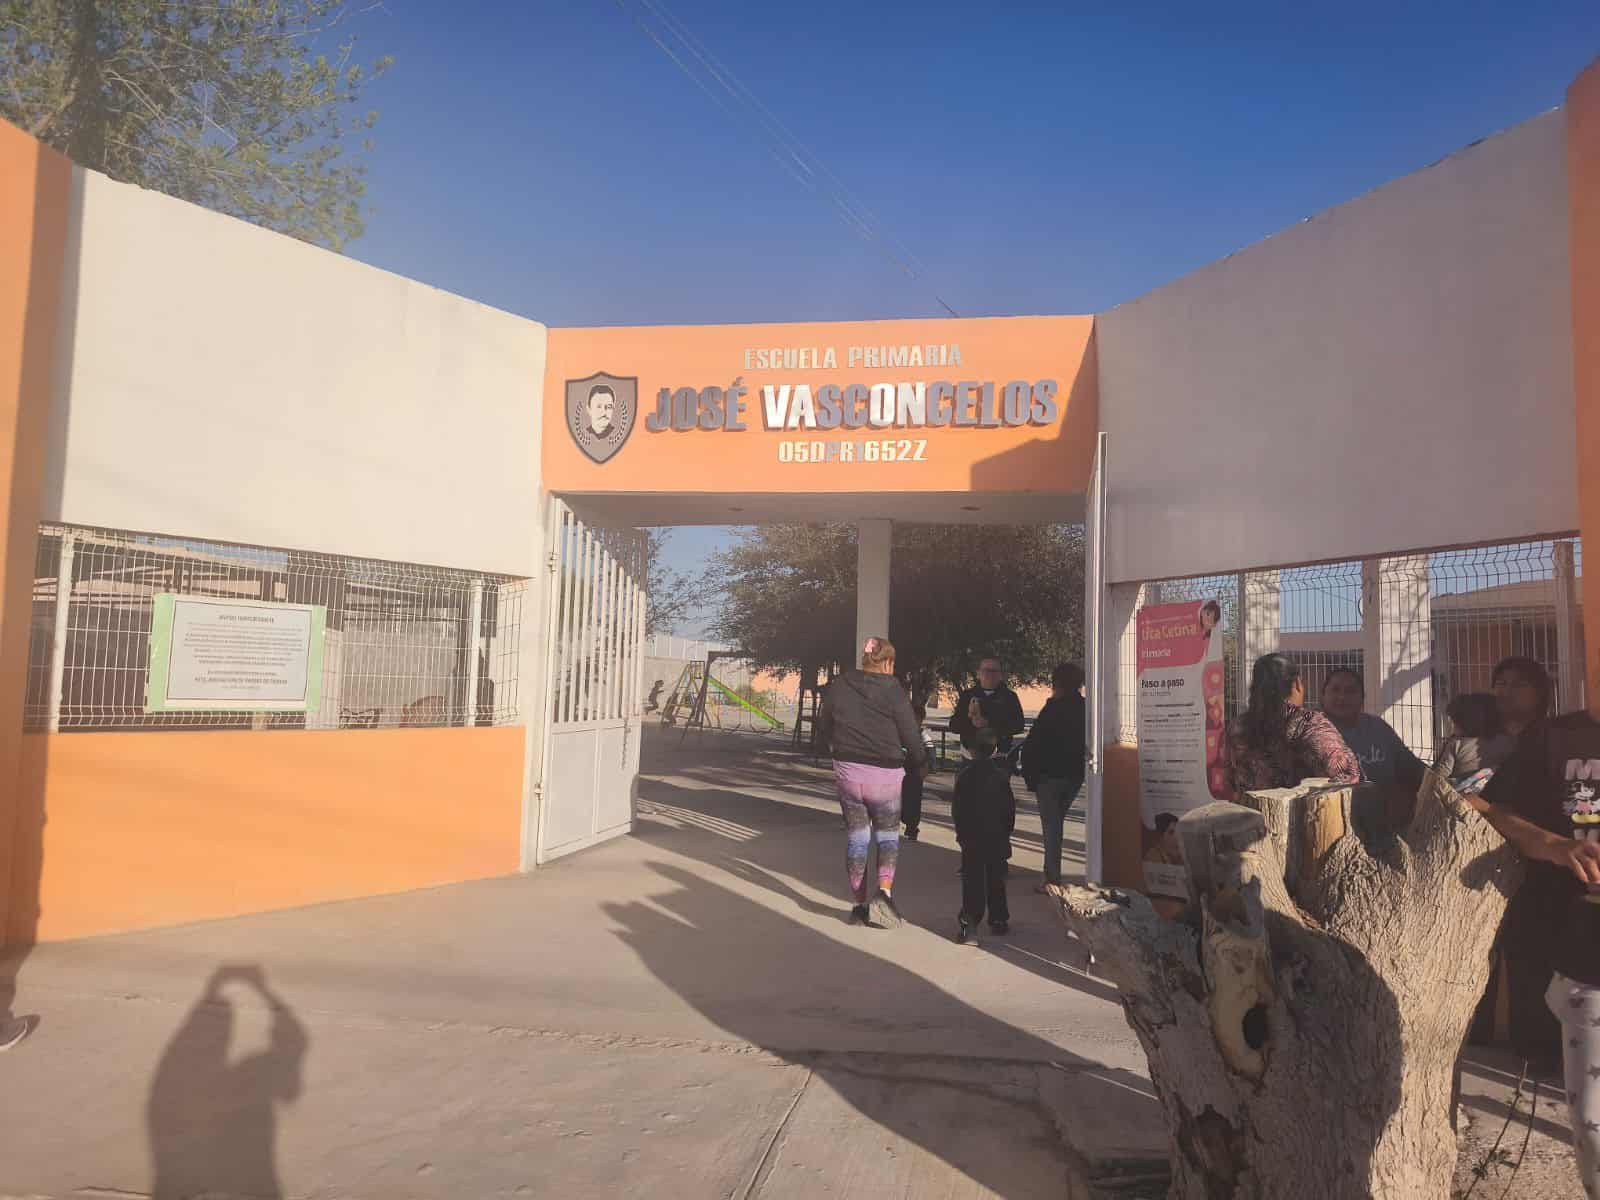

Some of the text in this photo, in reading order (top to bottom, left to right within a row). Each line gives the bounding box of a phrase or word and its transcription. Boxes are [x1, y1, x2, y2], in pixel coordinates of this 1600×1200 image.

[744, 343, 962, 369] ESCUELA PRIMARIA
[646, 376, 1058, 431] JOSÉ VASCONCELOS
